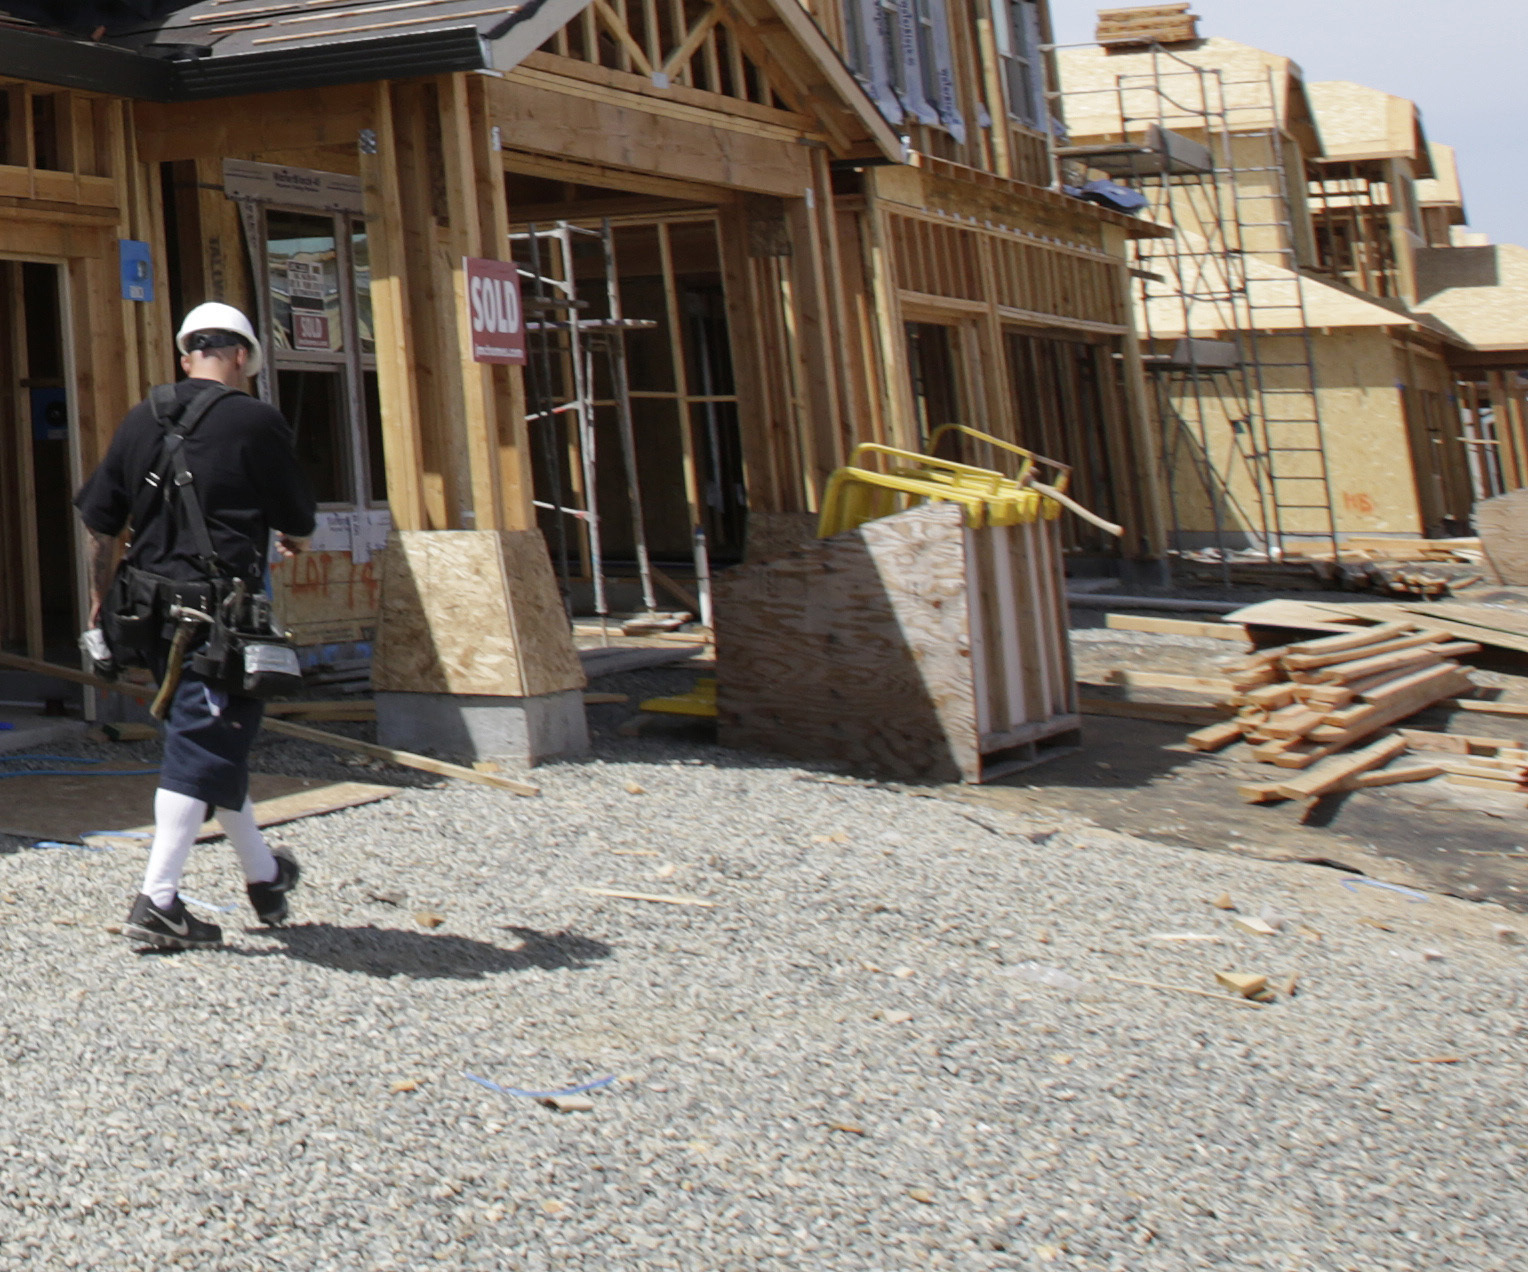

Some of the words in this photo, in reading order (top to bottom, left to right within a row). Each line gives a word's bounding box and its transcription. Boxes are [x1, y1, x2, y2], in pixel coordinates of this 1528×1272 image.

[471, 276, 519, 333] SOLD
[300, 316, 322, 338] SOLD
[292, 553, 332, 597] LOT
